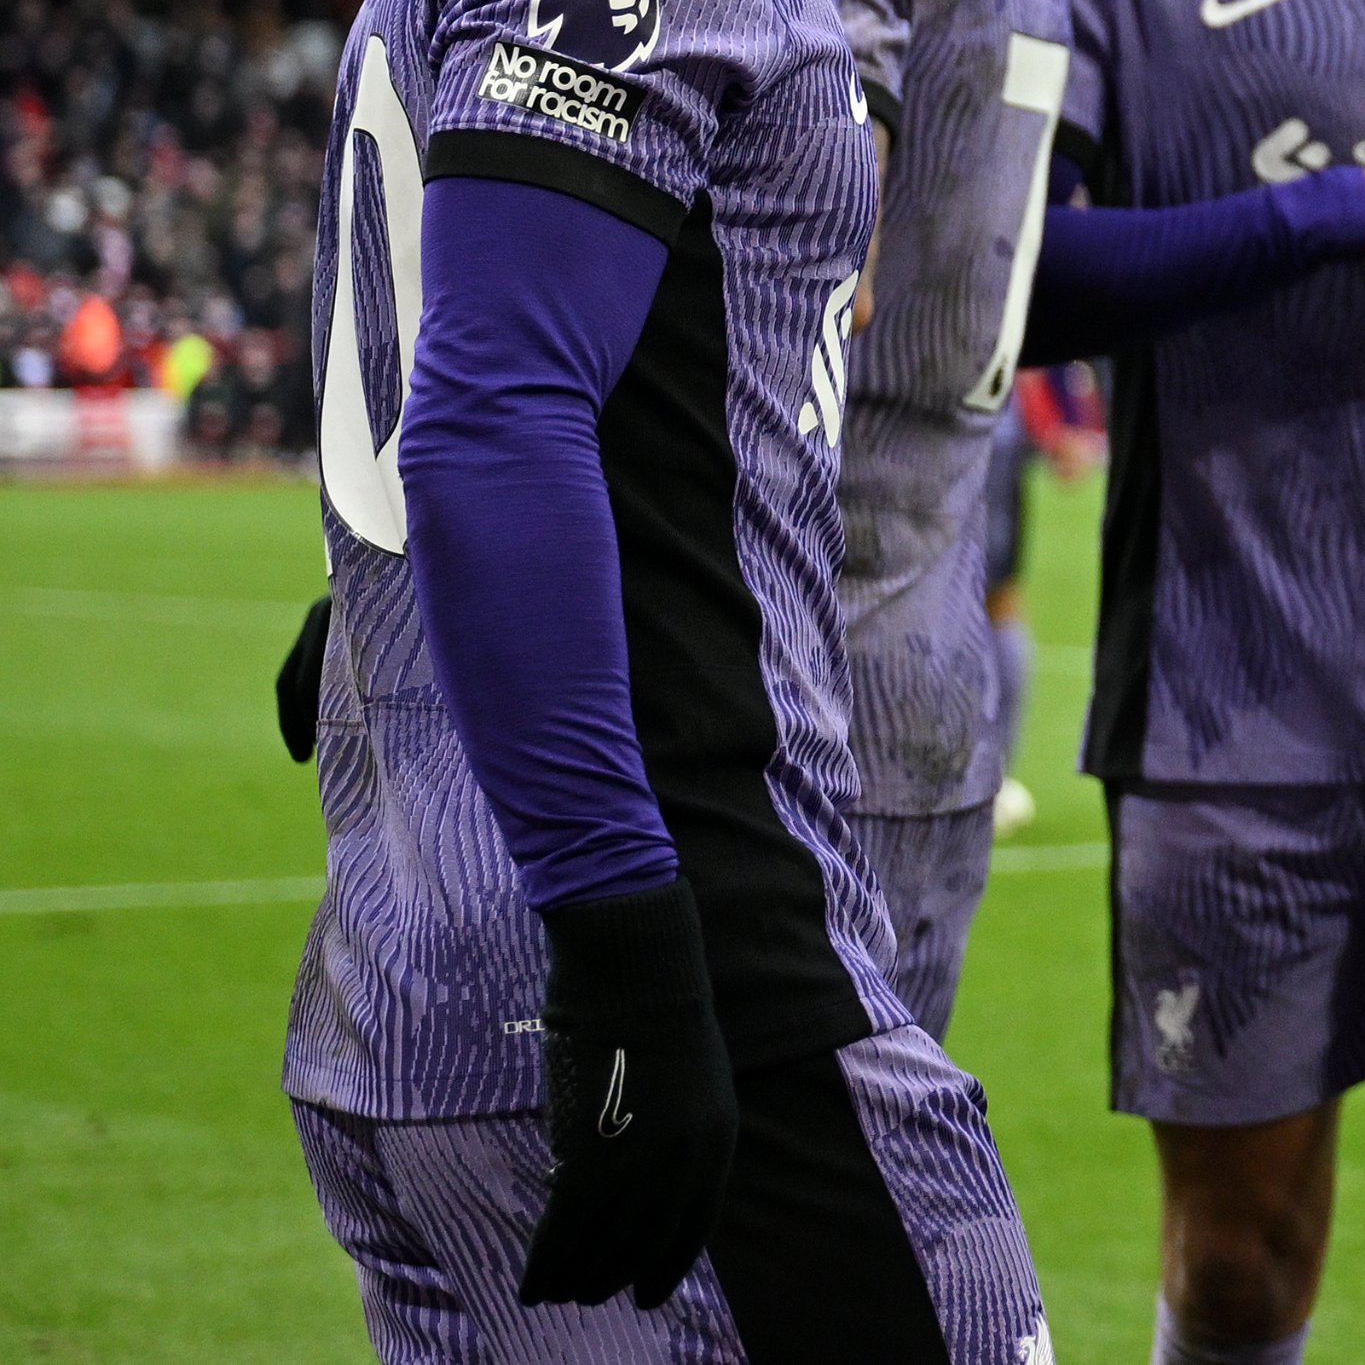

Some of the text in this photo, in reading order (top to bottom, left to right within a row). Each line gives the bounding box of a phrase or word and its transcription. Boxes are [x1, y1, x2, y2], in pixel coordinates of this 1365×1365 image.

[478, 69, 630, 143] for racism
[488, 42, 628, 112] No room
[962, 31, 1072, 412] 7
[319, 34, 423, 556] 0
[504, 1018, 546, 1035] DRI
